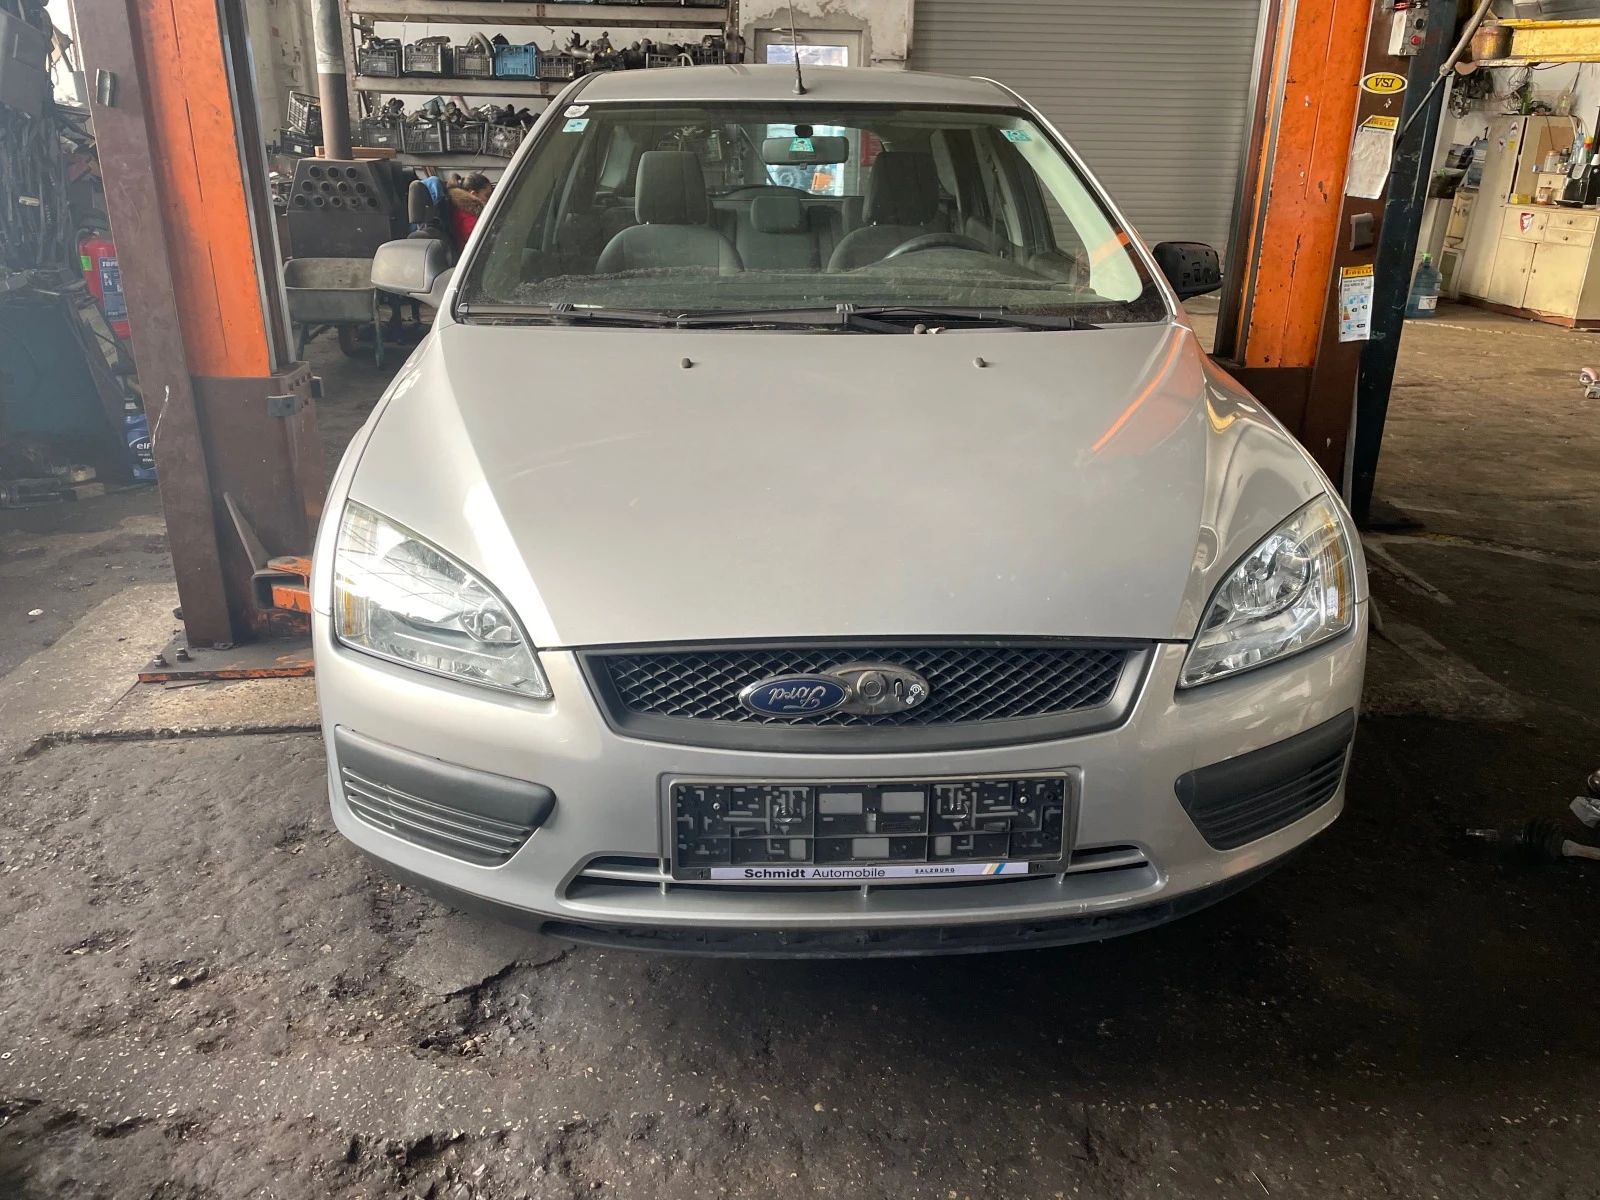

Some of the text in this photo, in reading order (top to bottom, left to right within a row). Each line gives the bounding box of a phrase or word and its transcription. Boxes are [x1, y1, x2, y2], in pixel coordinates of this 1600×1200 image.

[768, 685, 827, 710] Ford
[743, 868, 806, 879] Schmidt
[812, 867, 886, 879] Automobile
